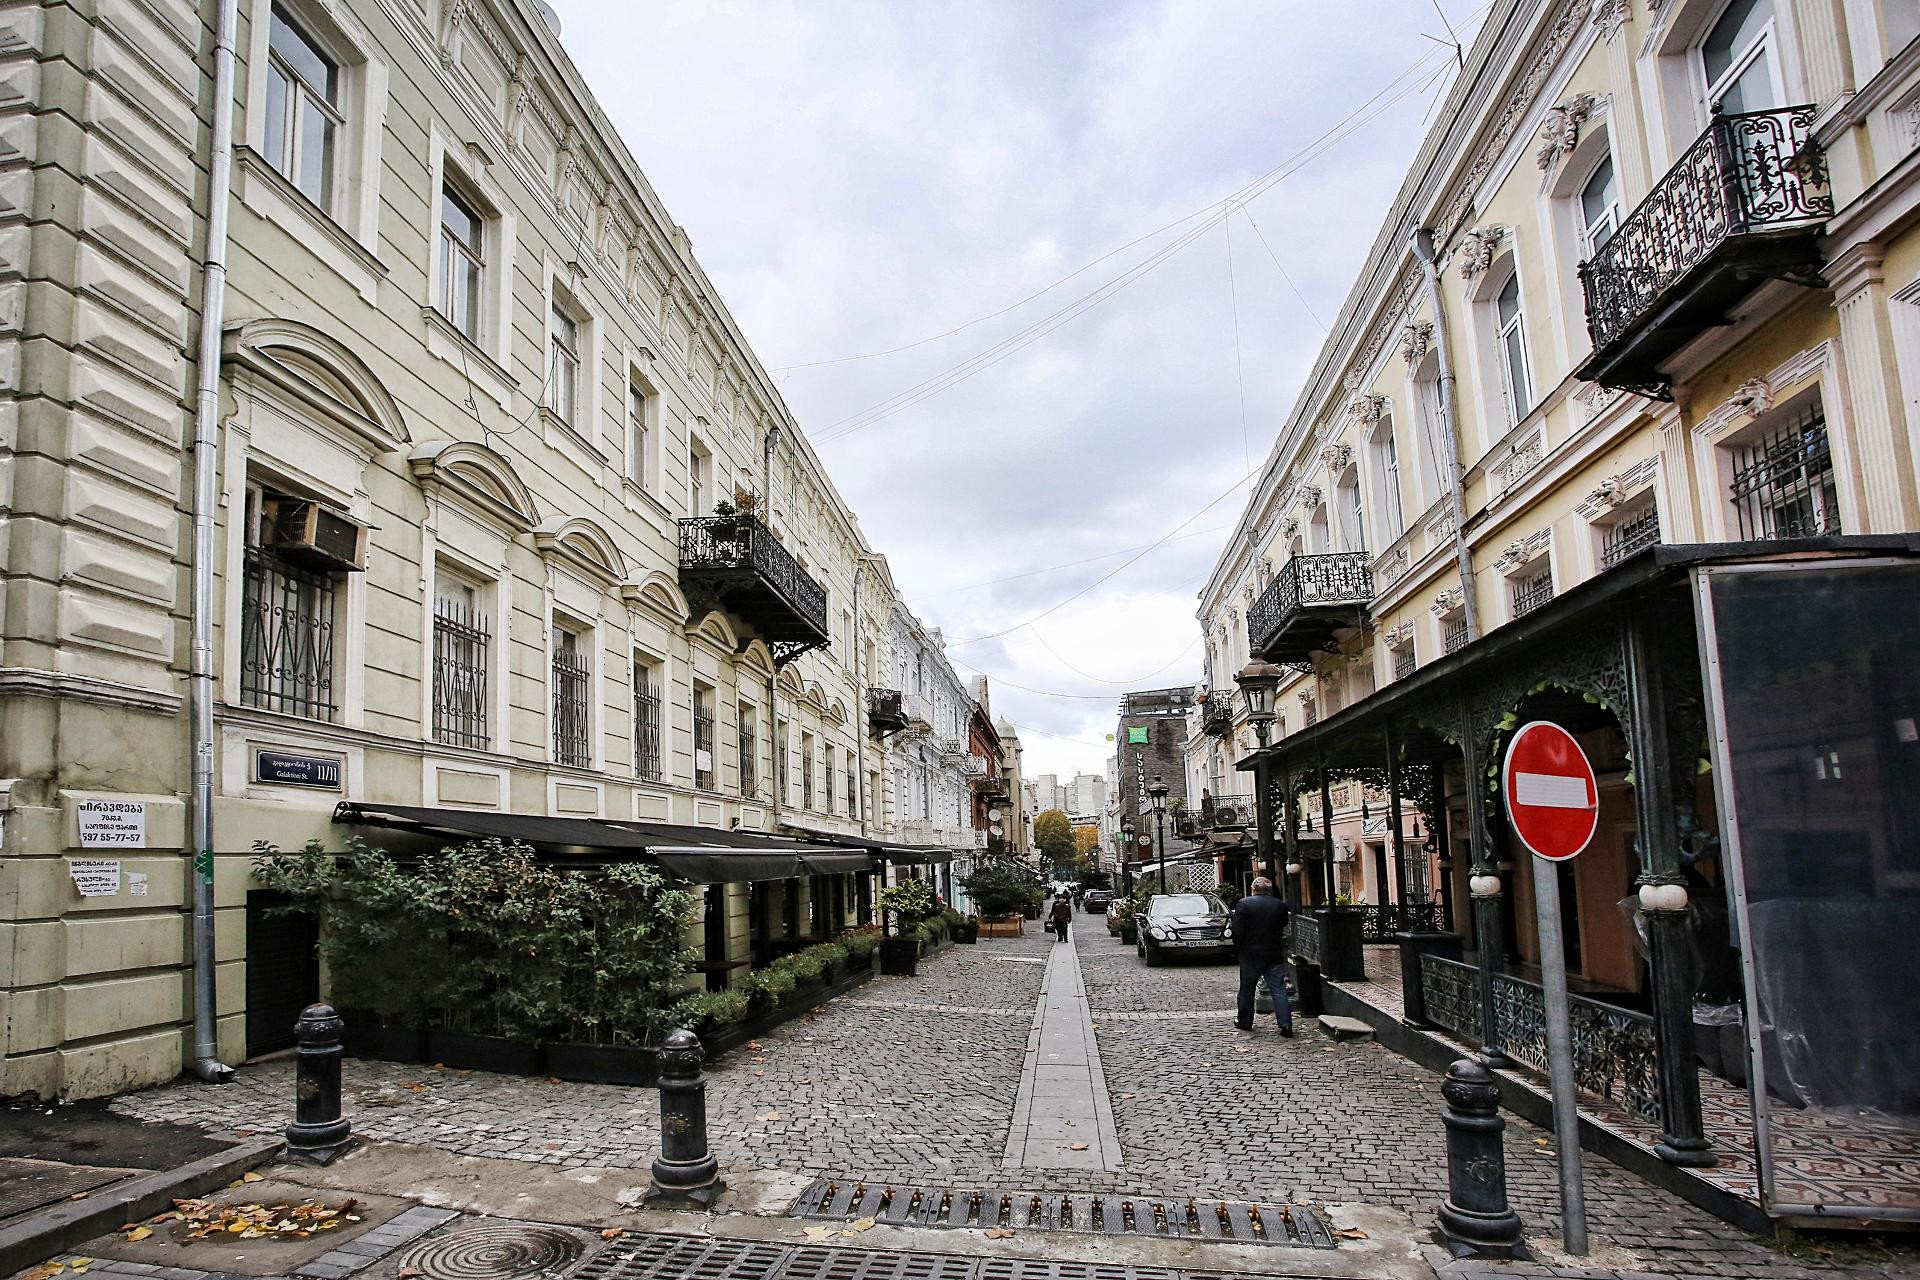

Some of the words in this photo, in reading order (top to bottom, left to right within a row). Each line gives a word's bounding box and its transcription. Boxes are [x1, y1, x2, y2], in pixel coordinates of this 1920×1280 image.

[317, 765, 337, 781] 11/11
[1136, 752, 1147, 804] სასტუმრ
[82, 833, 98, 841] 597
[100, 834, 141, 842] 55-77-57
